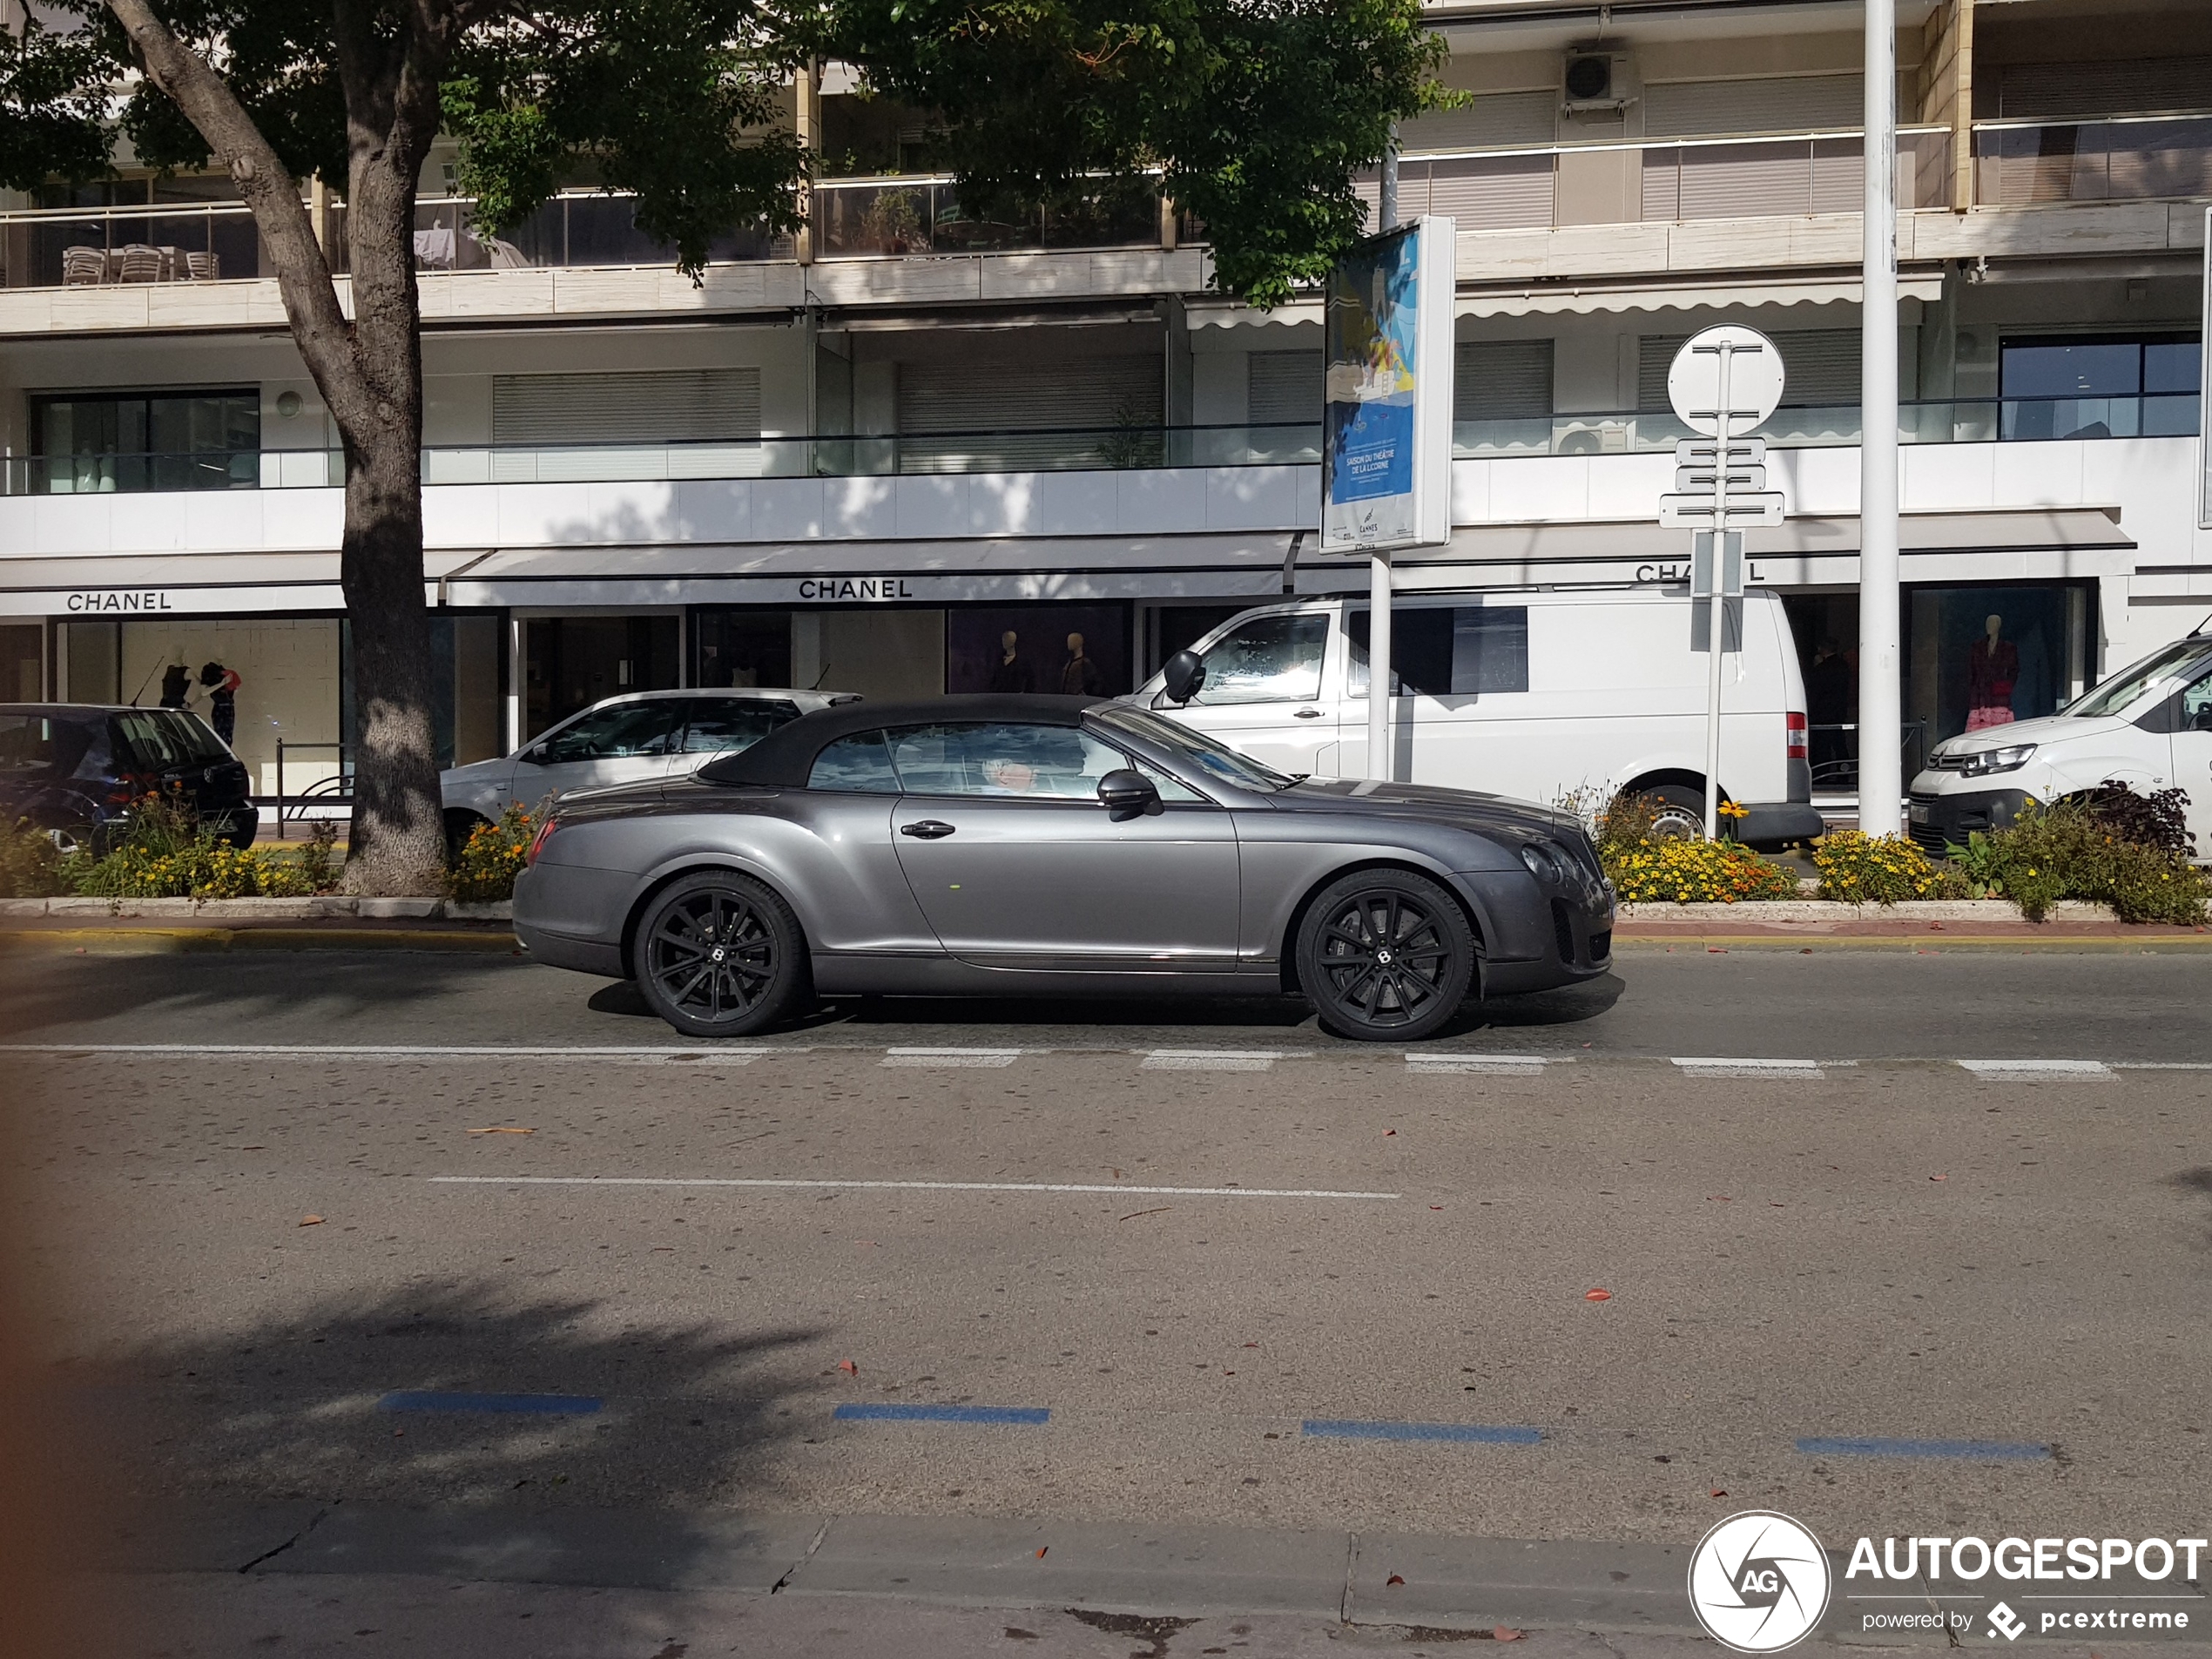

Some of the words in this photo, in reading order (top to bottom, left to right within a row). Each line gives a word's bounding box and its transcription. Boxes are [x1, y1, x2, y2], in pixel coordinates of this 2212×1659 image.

[1346, 455, 1365, 466] SAISON
[1366, 453, 1373, 462] DU
[1373, 448, 1395, 461] THÉÂTRE
[1352, 465, 1359, 475] DE
[1359, 463, 1367, 473] LA
[1367, 460, 1389, 472] LICORNE
[1635, 562, 1765, 582] CHL
[799, 579, 913, 598] CHANEL
[67, 592, 172, 610] CHANEL
